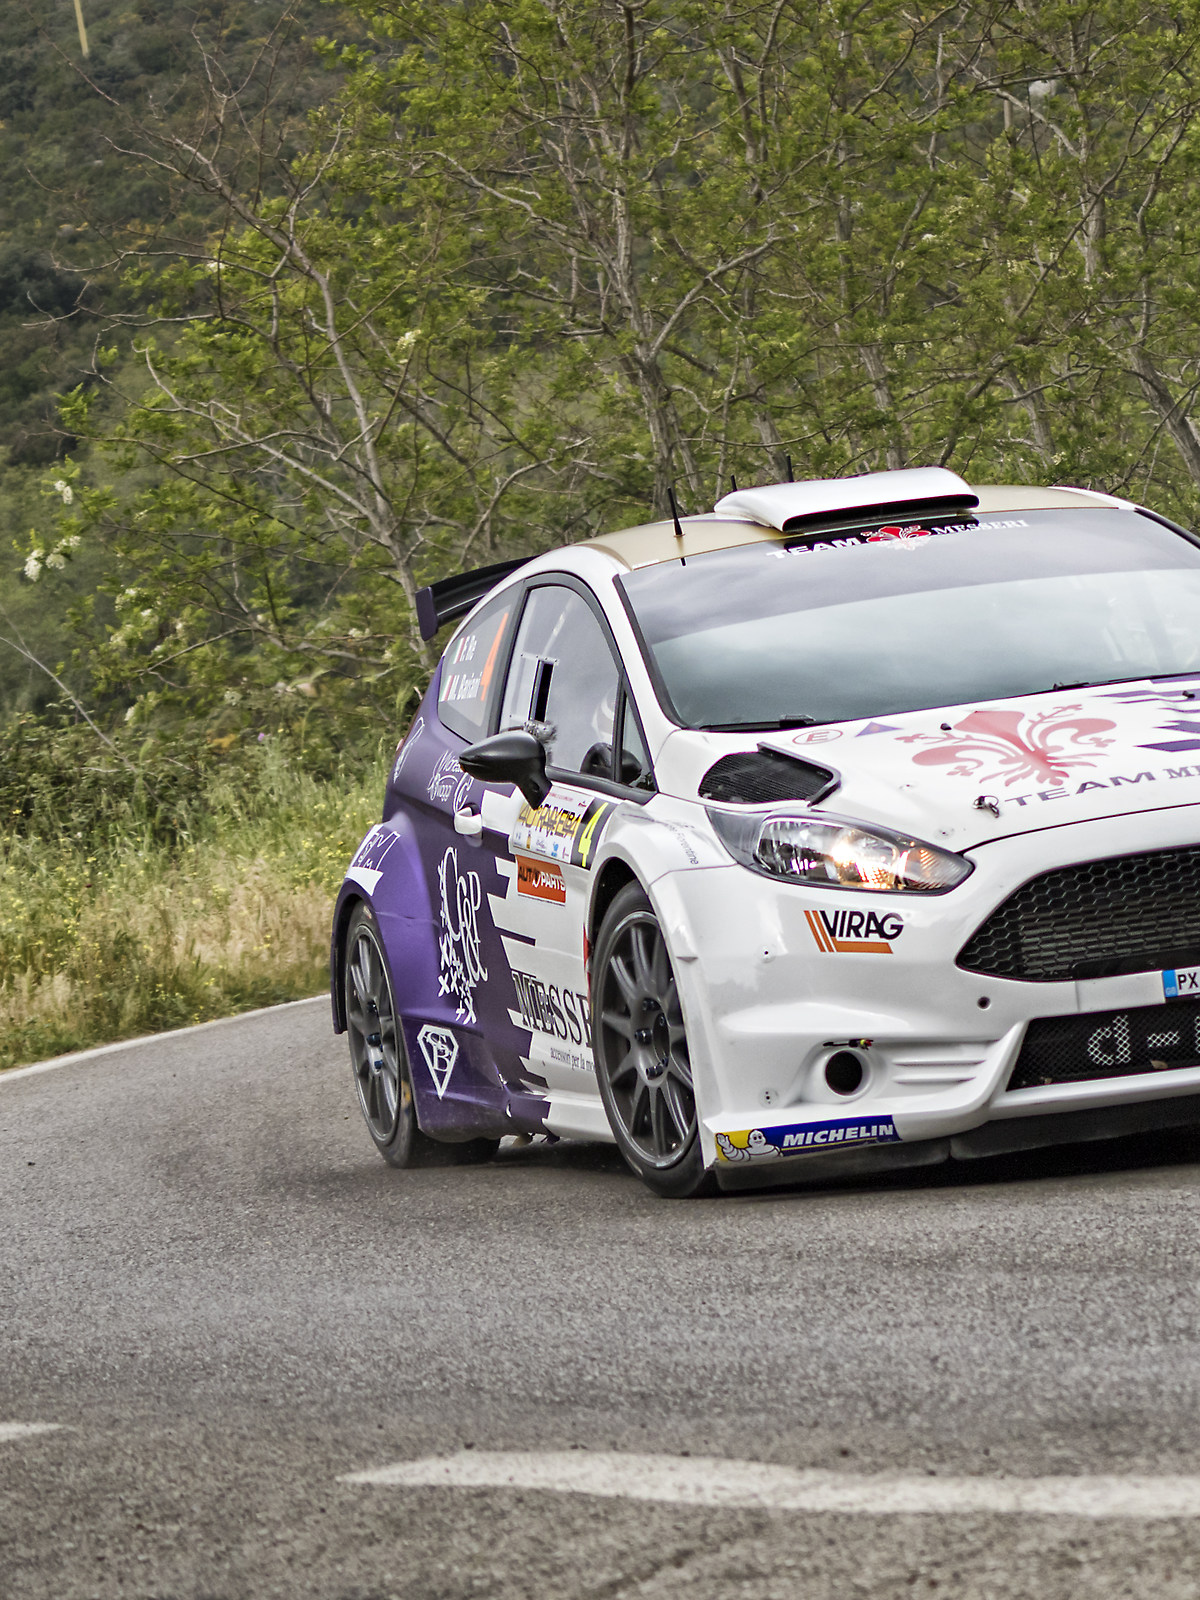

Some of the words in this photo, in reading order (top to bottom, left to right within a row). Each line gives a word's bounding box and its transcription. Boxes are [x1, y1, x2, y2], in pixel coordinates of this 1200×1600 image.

[766, 537, 862, 559] TEAM
[931, 519, 1030, 535] MESSERI
[1004, 771, 1157, 807] TEAM
[578, 801, 609, 868] 4
[819, 910, 905, 940] VIRAG
[1177, 971, 1199, 990] PX
[782, 1123, 894, 1147] MICHELIN
